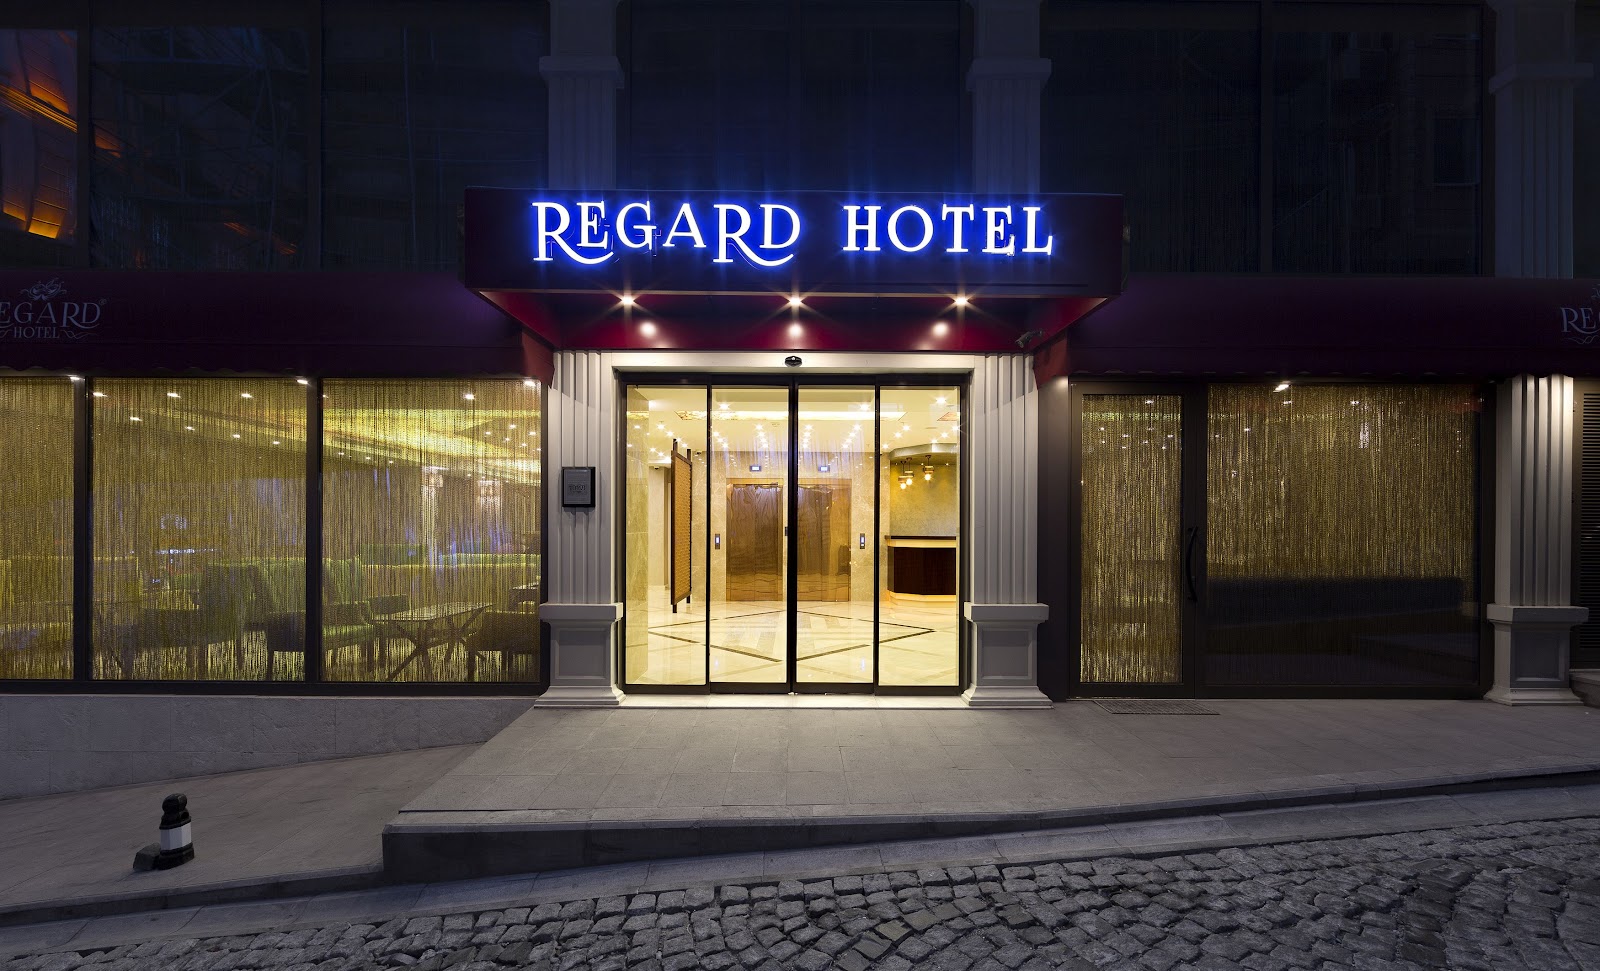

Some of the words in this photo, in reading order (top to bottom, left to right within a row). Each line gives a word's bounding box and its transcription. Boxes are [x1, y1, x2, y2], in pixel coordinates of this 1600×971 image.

[532, 200, 801, 267] REGARD
[842, 203, 1053, 256] HOTEL
[0, 301, 101, 329] EGARD
[1560, 307, 1600, 334] RE
[14, 326, 60, 339] HOTEL
